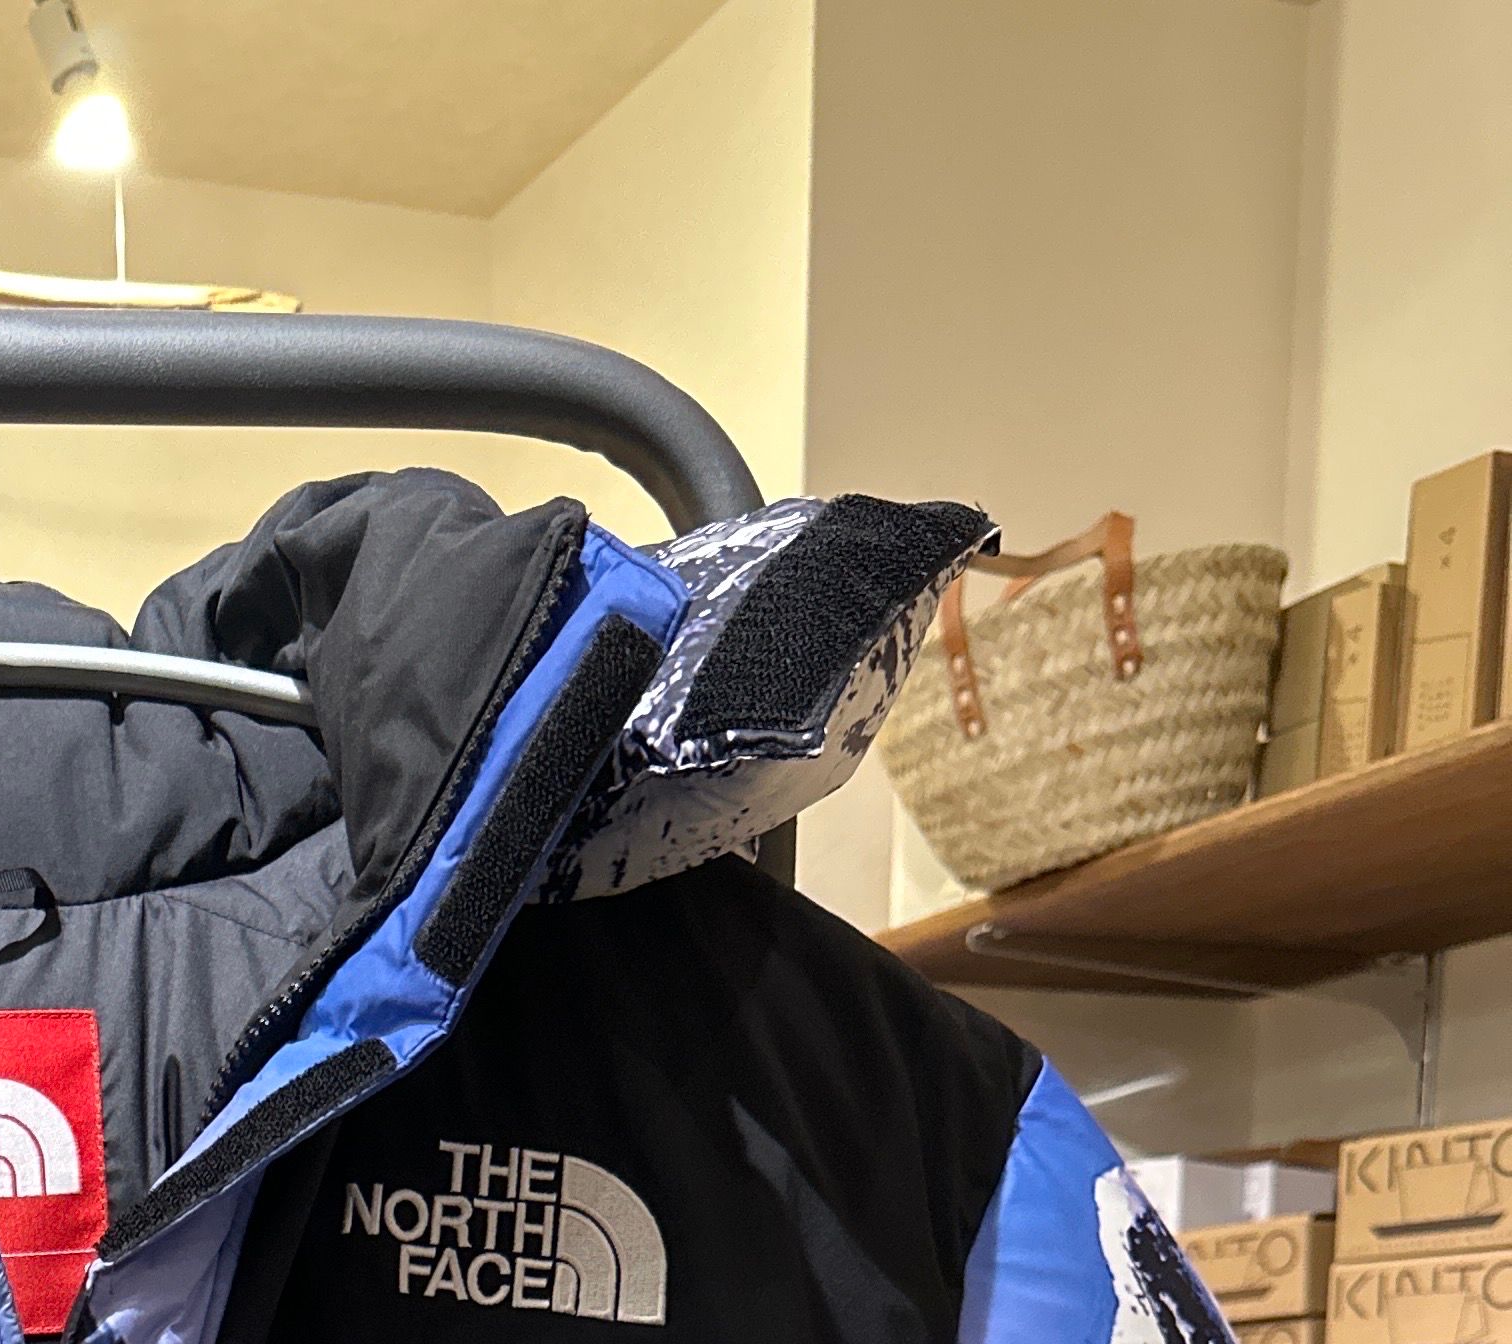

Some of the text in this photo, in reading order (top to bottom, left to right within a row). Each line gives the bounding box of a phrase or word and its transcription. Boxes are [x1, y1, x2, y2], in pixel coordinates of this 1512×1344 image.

[439, 1139, 561, 1203] THE
[341, 1182, 555, 1257] NORTH
[398, 1244, 554, 1310] FACE
